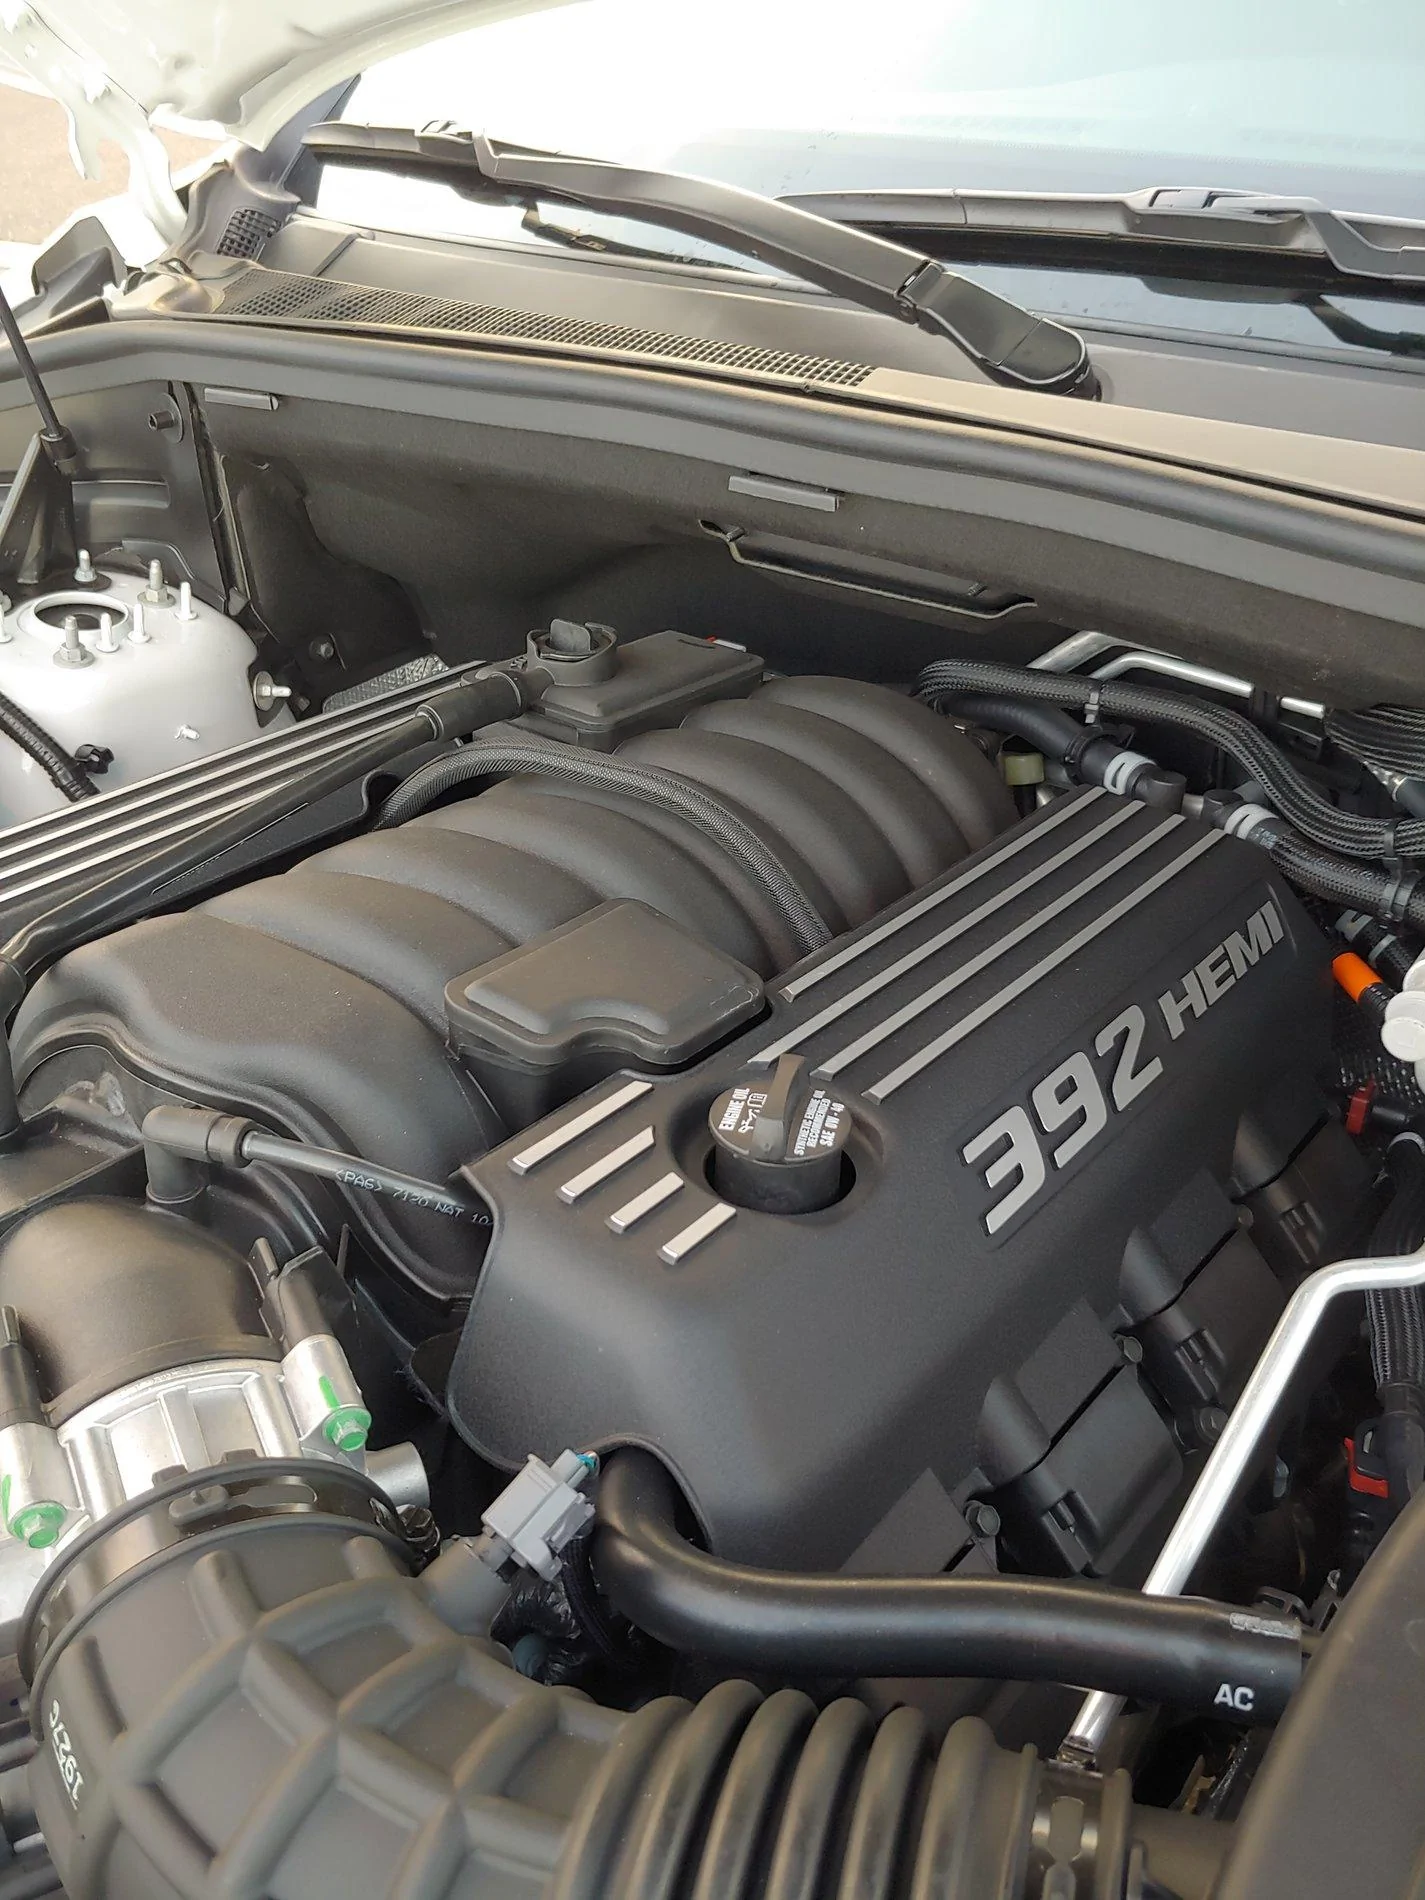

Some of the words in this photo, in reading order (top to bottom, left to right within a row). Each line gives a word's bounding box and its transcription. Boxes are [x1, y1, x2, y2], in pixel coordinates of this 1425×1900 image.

[962, 1004, 1164, 1235] 392
[1157, 900, 1285, 1041] HEMI
[718, 1099, 746, 1131] ENGINE
[732, 1088, 750, 1100] OIL
[793, 1119, 813, 1156] SYNTHETIC
[804, 1098, 820, 1119] ENGINE
[806, 1098, 831, 1148] RECOMMENDED
[819, 1129, 836, 1147] SAE
[434, 1201, 465, 1218] NAT
[1213, 1683, 1254, 1711] AC
